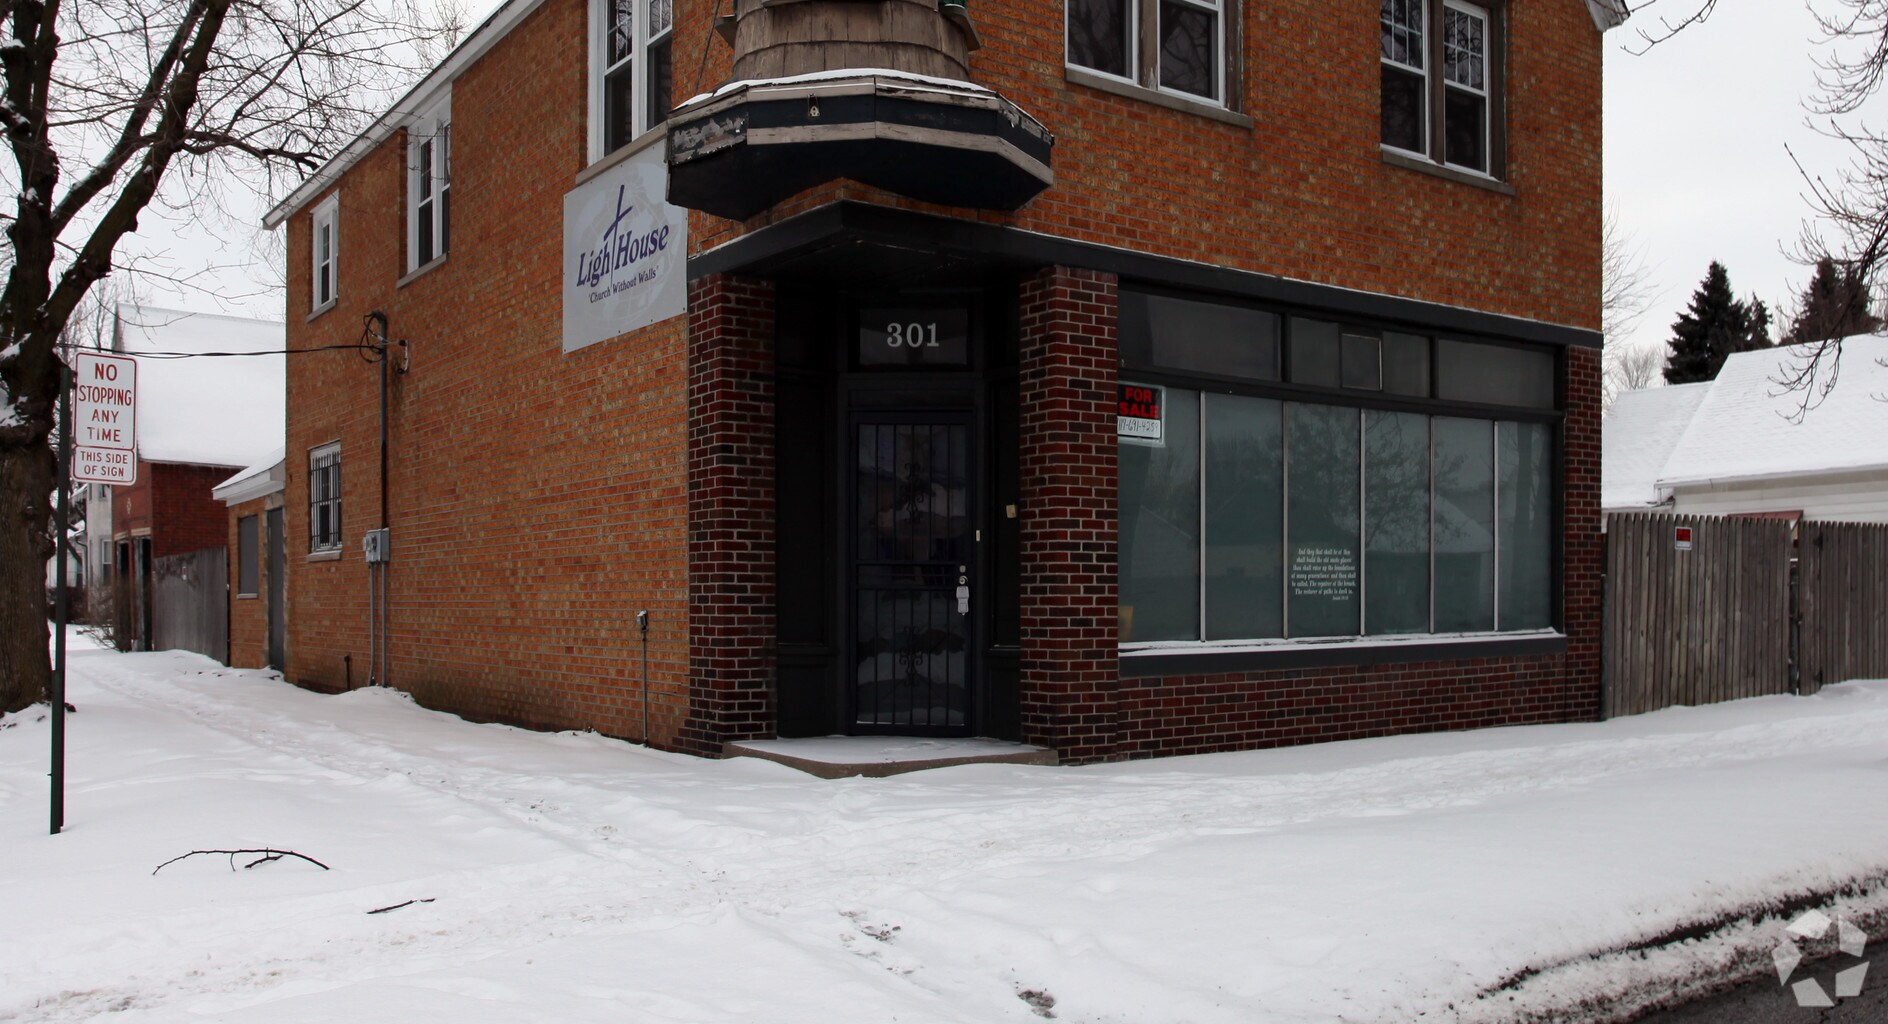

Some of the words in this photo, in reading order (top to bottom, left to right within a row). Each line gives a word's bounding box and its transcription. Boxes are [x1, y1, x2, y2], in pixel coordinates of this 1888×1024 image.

[612, 276, 637, 295] Without
[887, 322, 940, 348] 301
[94, 362, 118, 381] NO
[78, 384, 132, 406] STOPPING
[1124, 386, 1153, 403] FOR
[91, 408, 119, 424] ANY
[1119, 401, 1161, 419] SALE
[86, 426, 121, 442] TIME
[80, 450, 102, 462] THIS
[105, 452, 128, 464] SIDE
[83, 464, 98, 475] OF
[100, 465, 124, 477] SIGN
